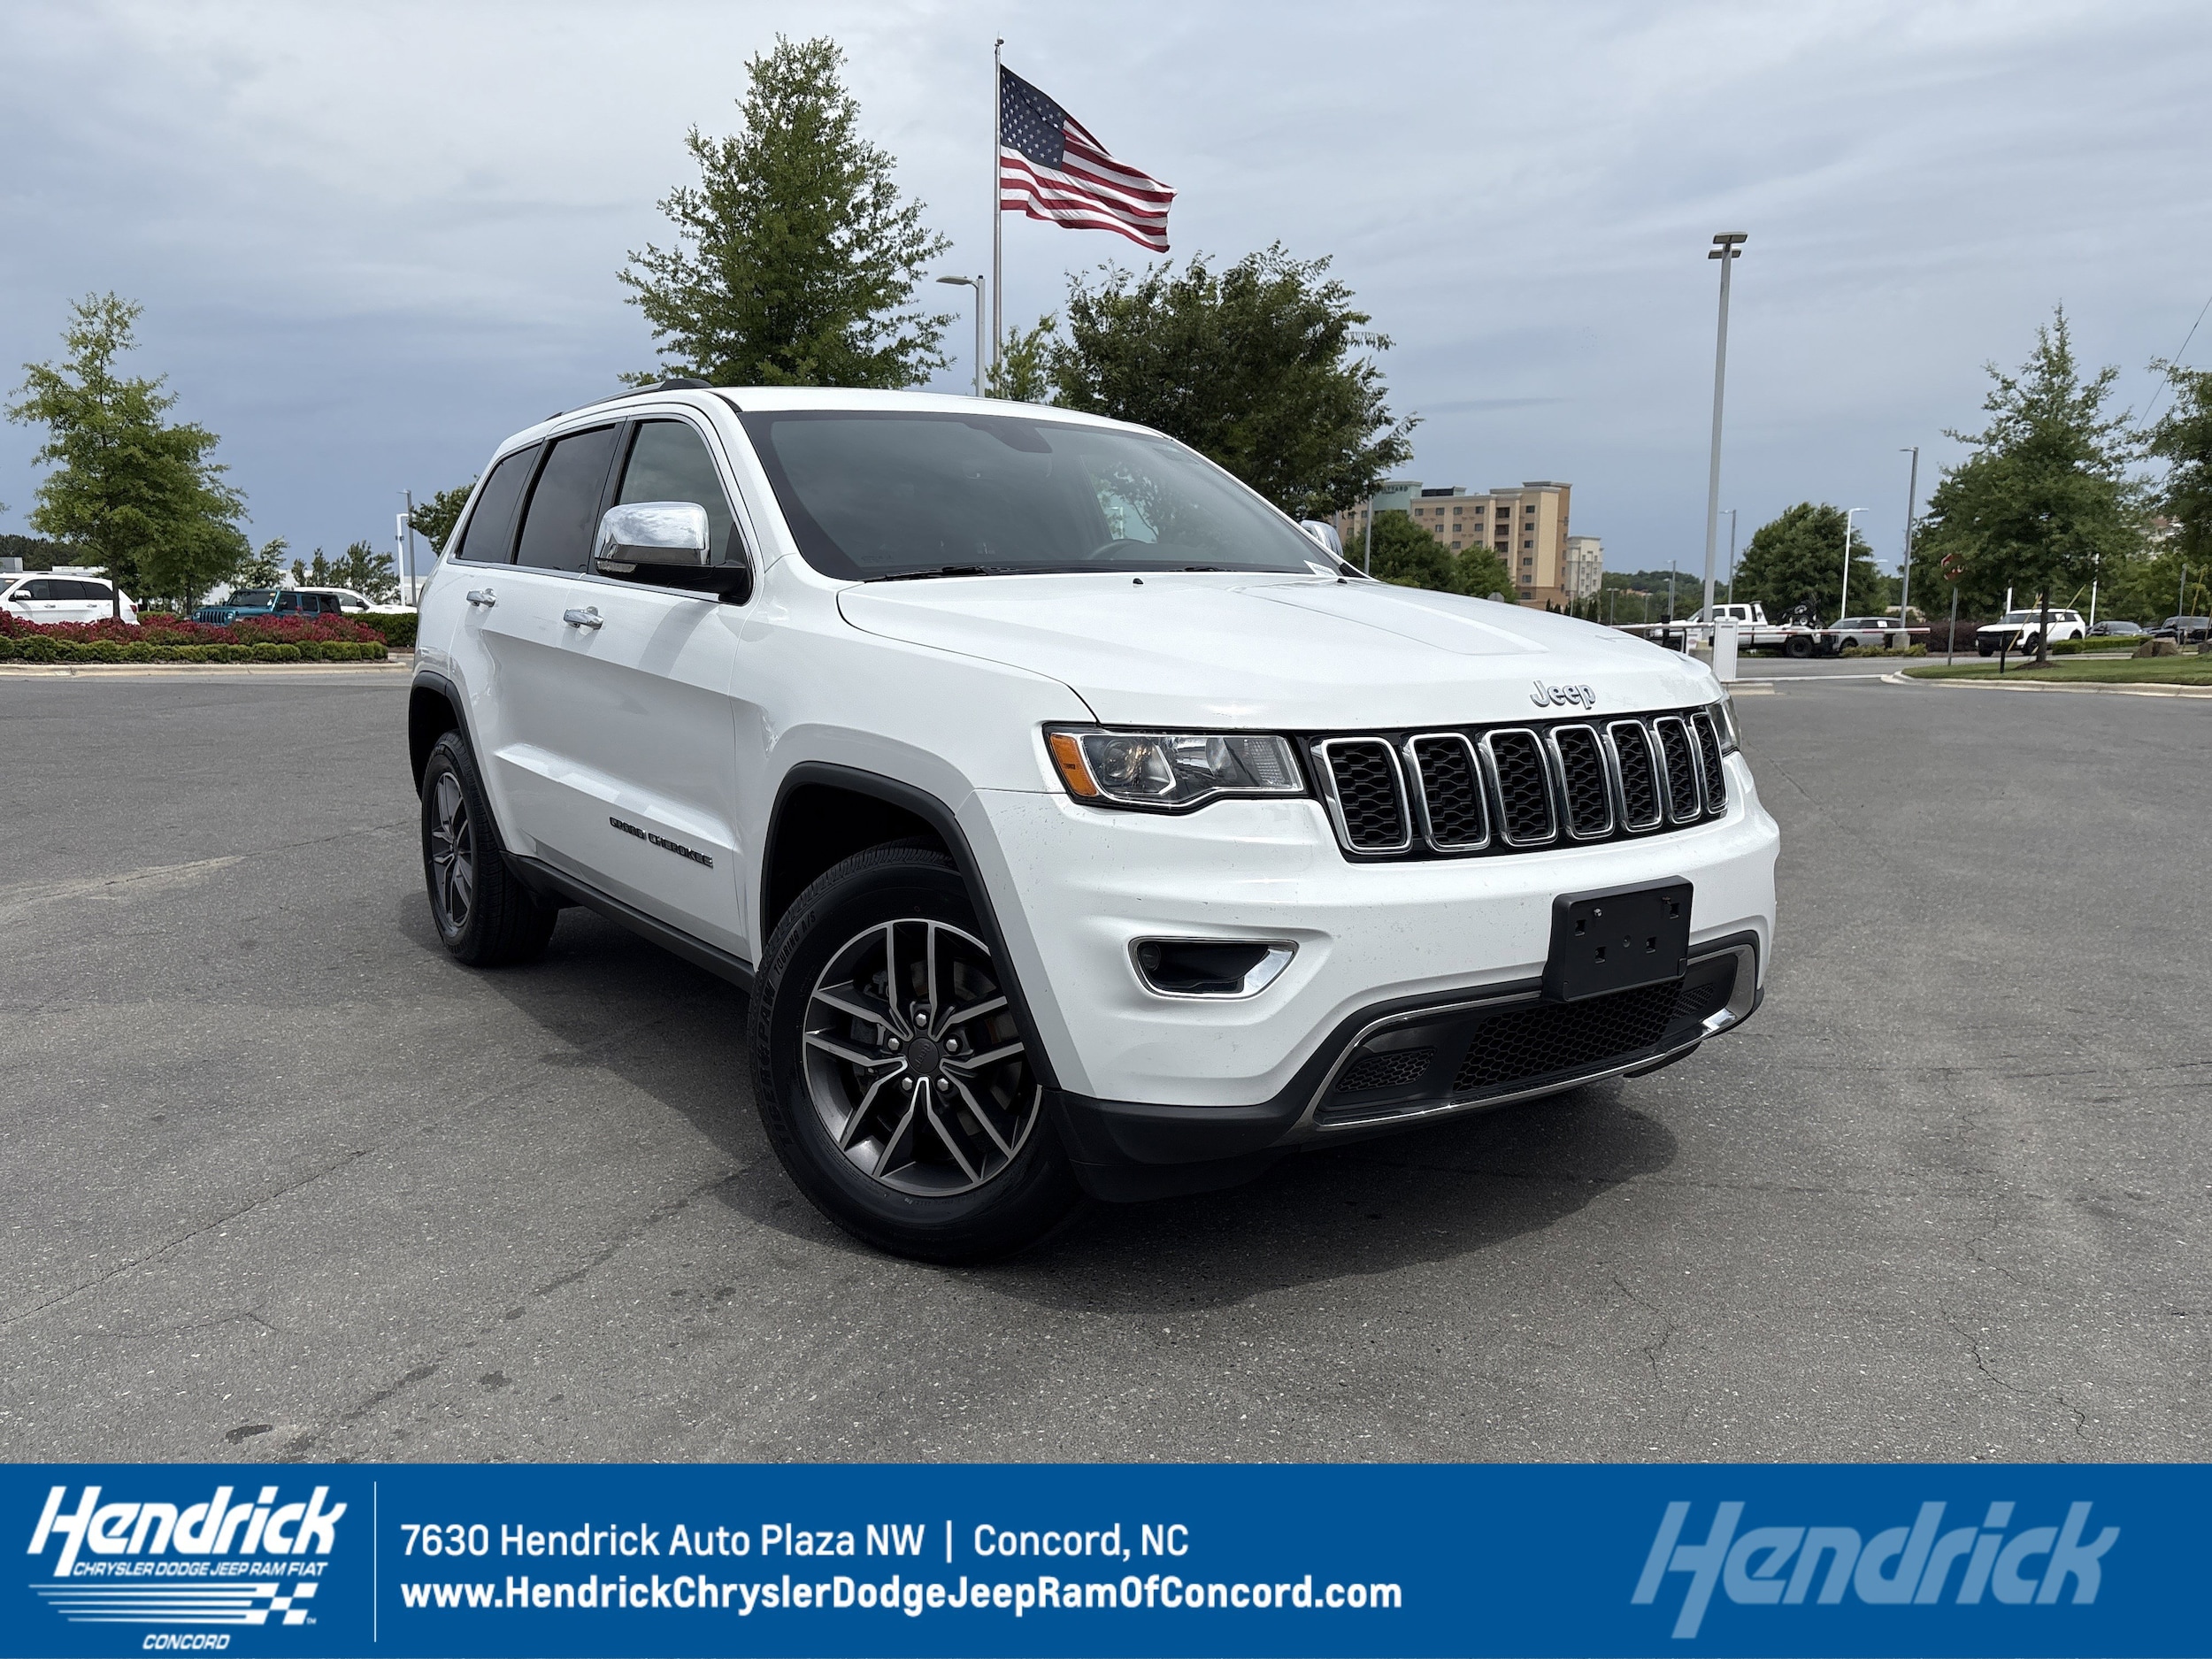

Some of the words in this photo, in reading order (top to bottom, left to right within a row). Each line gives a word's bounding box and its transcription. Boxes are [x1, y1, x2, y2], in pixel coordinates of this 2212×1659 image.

[1530, 680, 1596, 710] Jeep
[609, 817, 647, 841] GRAND
[648, 833, 714, 869] CHEROKEE
[758, 979, 777, 1044] PAW
[773, 930, 800, 975] TOURING
[802, 910, 817, 933] A/S
